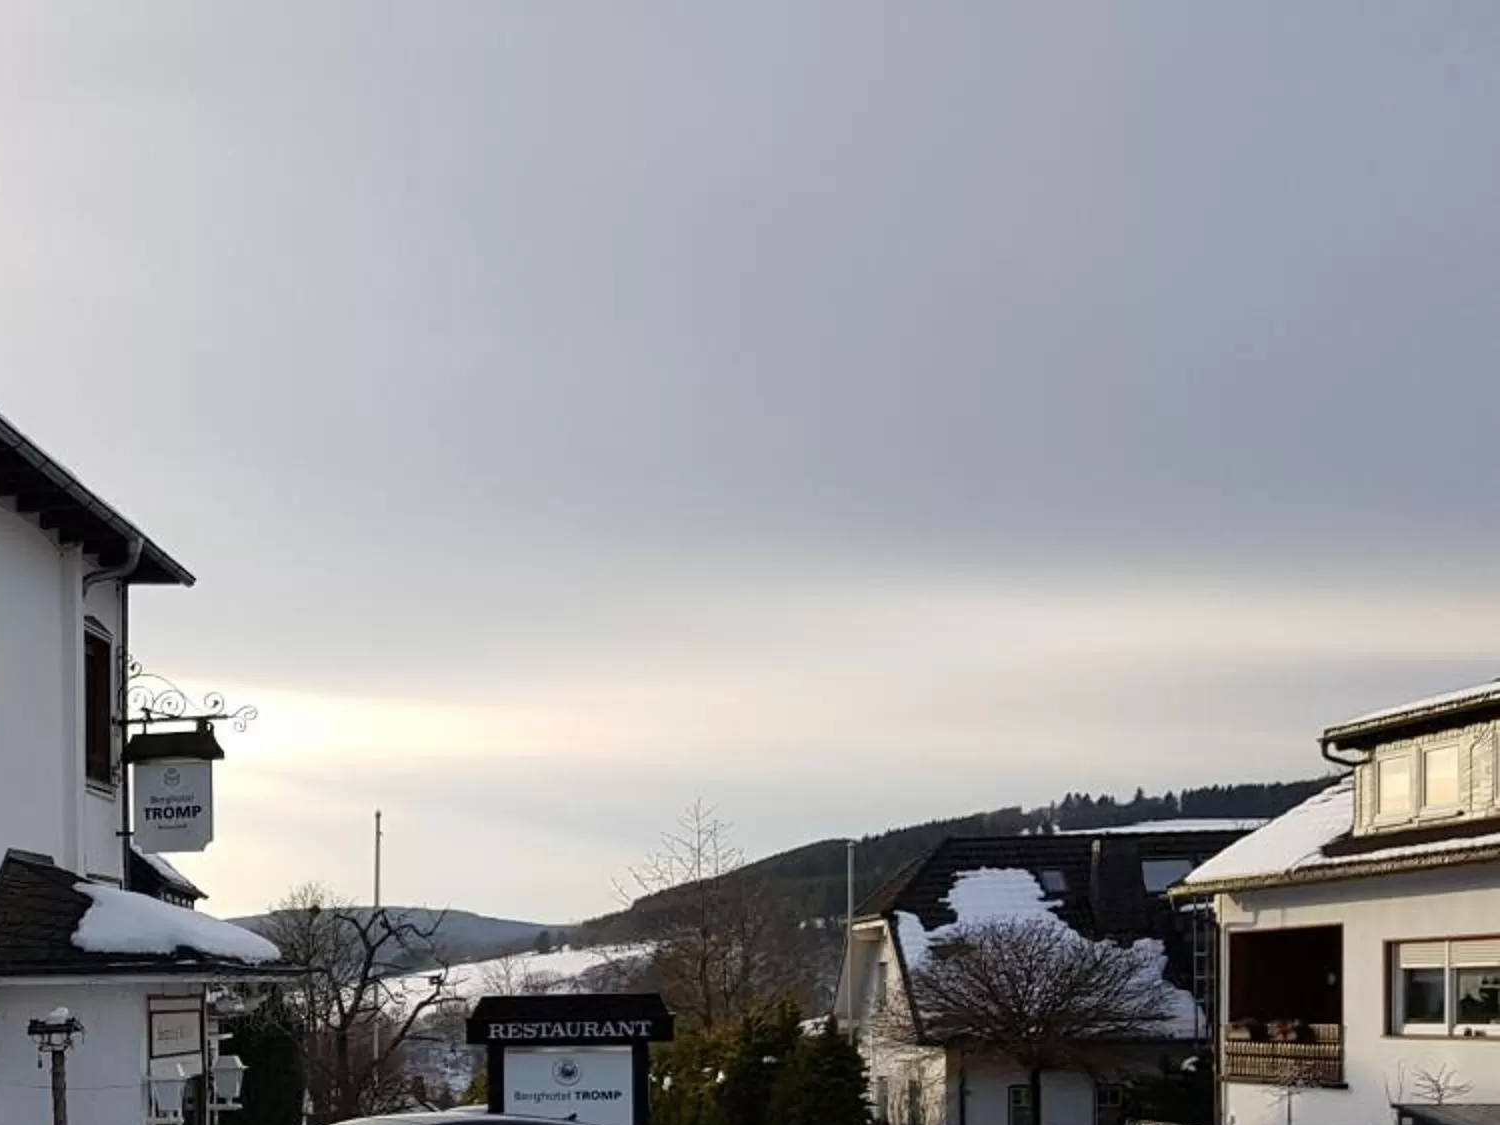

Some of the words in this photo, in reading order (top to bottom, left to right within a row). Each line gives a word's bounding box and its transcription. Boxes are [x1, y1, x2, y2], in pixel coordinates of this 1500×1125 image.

[144, 805, 202, 821] TROMP
[488, 1020, 653, 1039] RESTAURANT
[574, 1089, 623, 1101] TROMP
